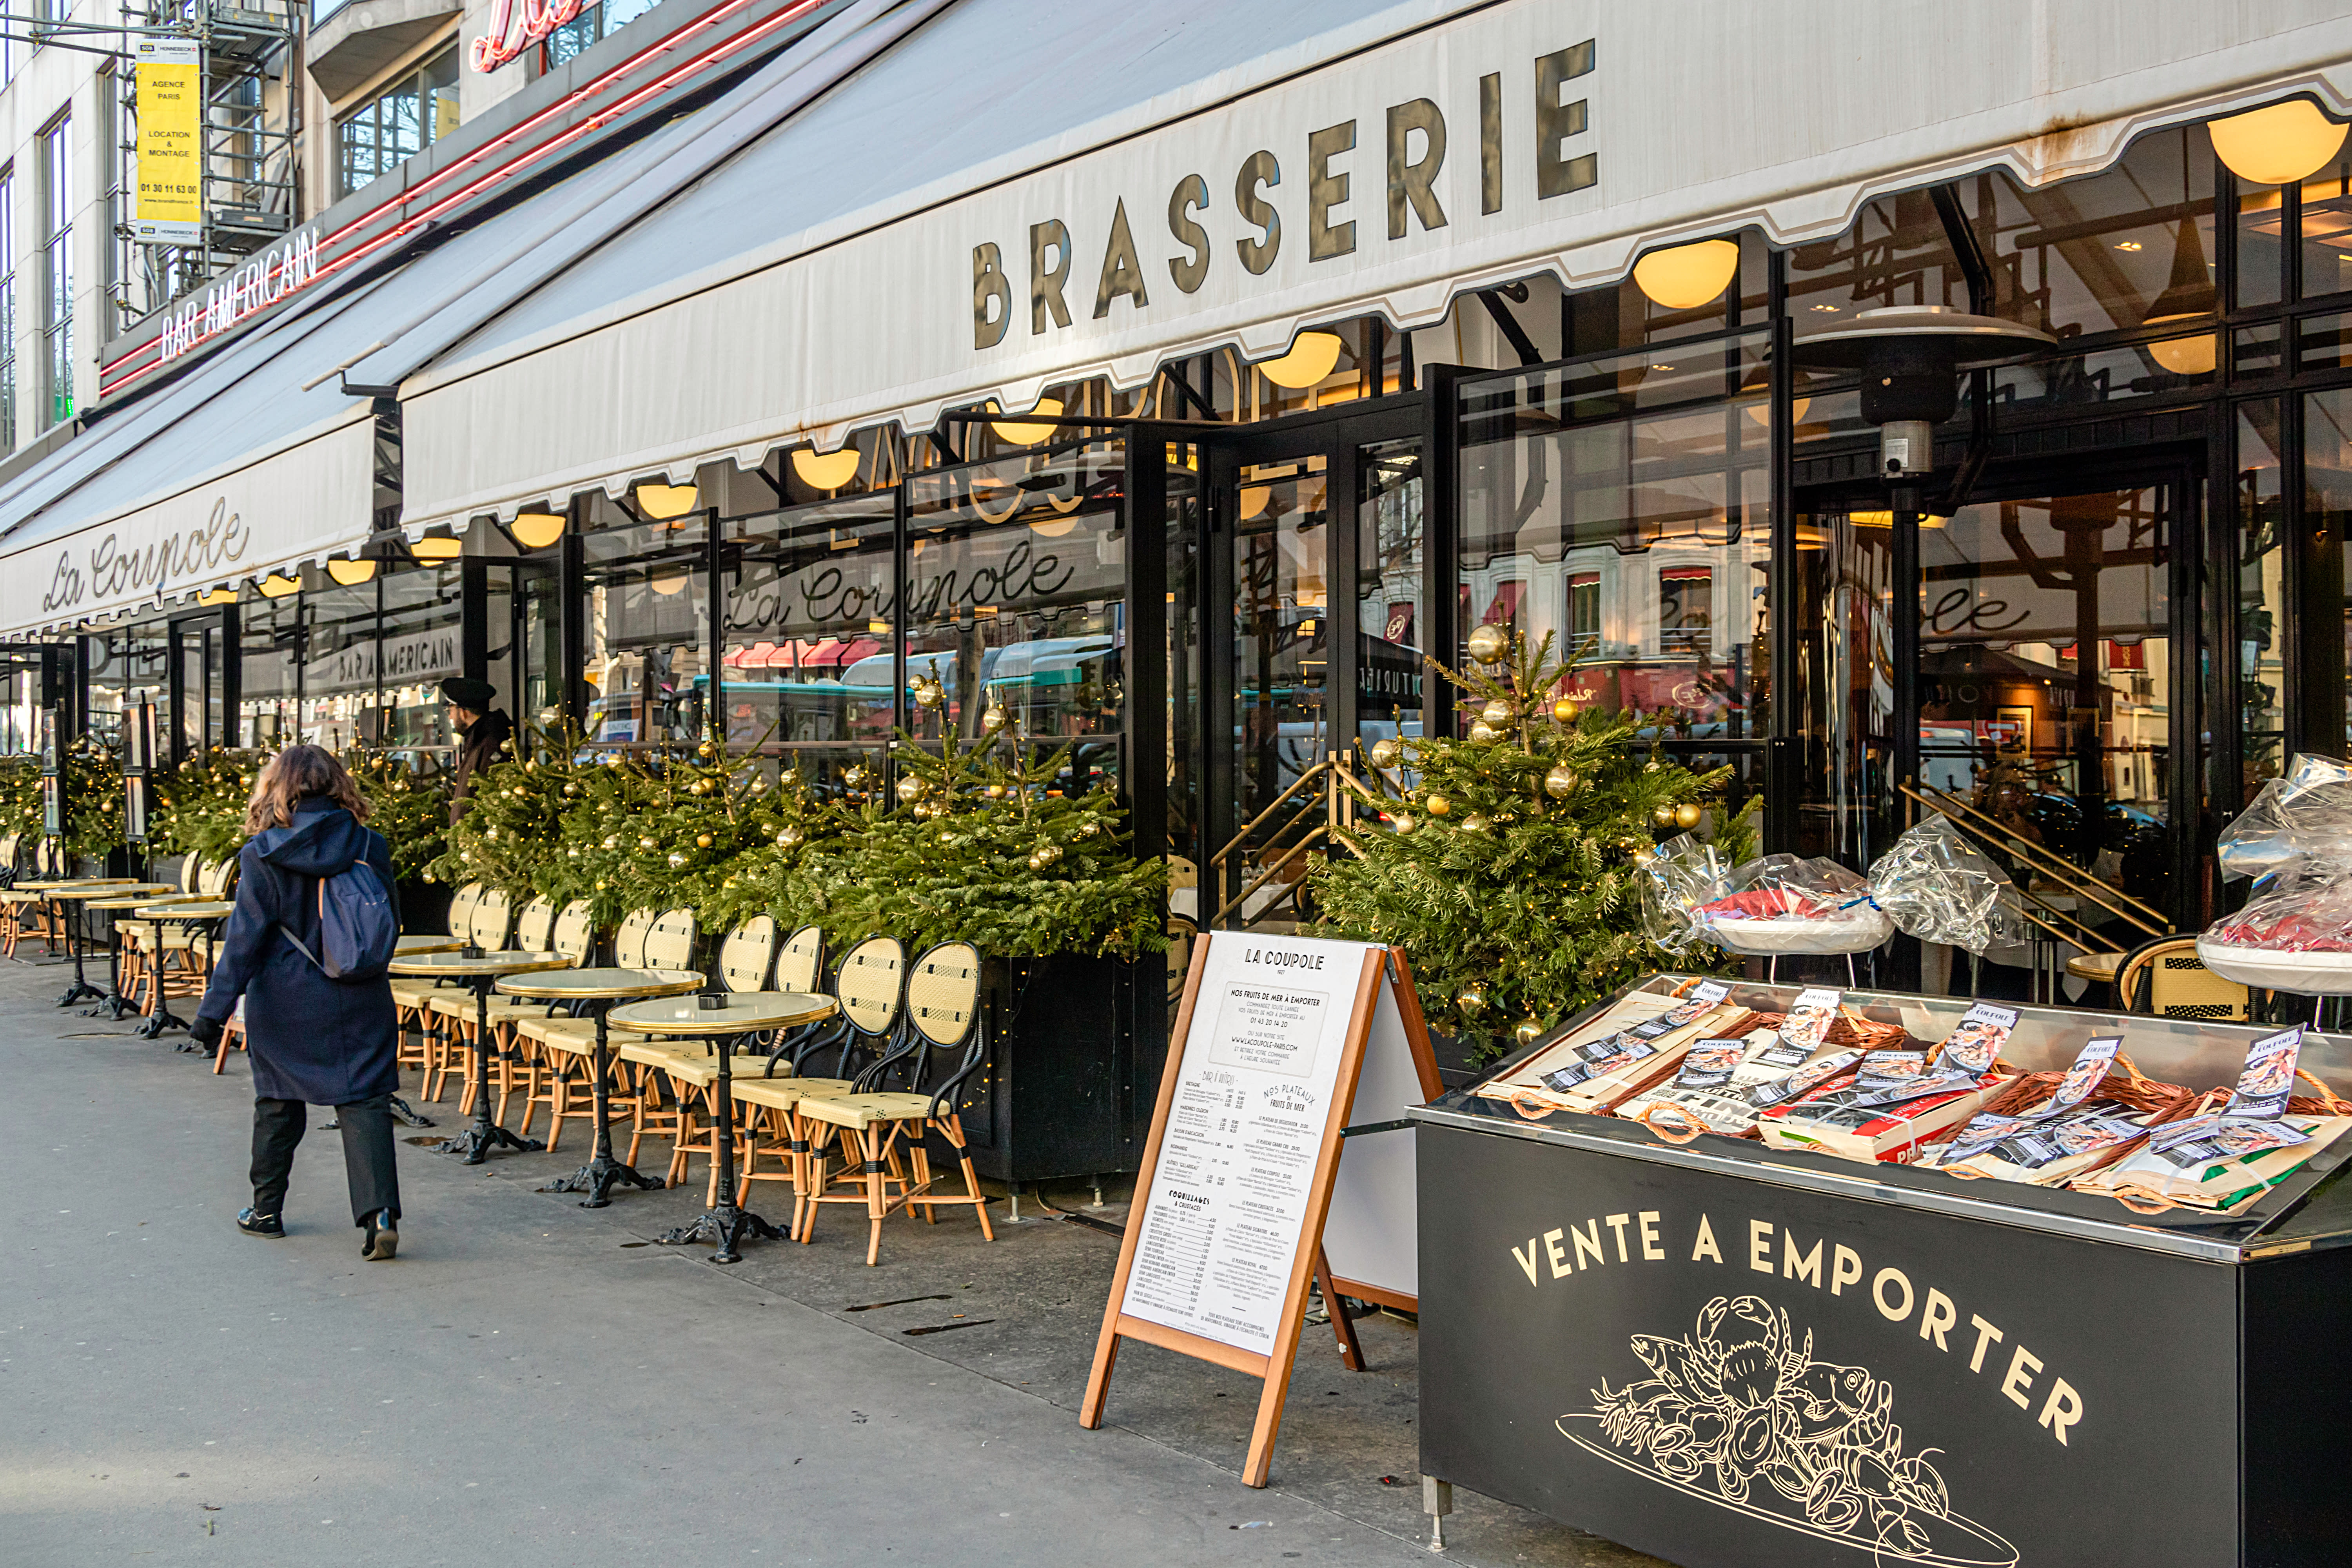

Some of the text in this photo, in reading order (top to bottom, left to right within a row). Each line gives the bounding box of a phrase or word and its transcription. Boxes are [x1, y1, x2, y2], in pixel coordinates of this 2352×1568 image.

[149, 149, 190, 158] MONTAGE
[141, 183, 150, 192] 01
[176, 185, 185, 193] 63
[188, 185, 197, 194] 00
[973, 38, 1599, 351] BRASSERIE
[162, 226, 317, 363] BAR AMERICAIN
[44, 496, 250, 612] La Coupole
[339, 653, 362, 682] BAR
[1245, 949, 1324, 970] LA COUPOLE
[1243, 990, 1261, 999] FRUITS
[1284, 994, 1289, 1003] À
[1290, 996, 1320, 1006] EMPORTER
[1701, 986, 1723, 998] COUPOLE
[1246, 1001, 1270, 1009] COMMANDEZ
[1976, 1009, 2009, 1021] COUPOLE
[1232, 1037, 1298, 1051] WWW.LACOUPOLE-PARIS.COM
[2258, 1036, 2293, 1053] COUPOLE
[1279, 1084, 1316, 1106] PLATEAUX
[1270, 1099, 1305, 1112] FRUITS DE MER
[1169, 1190, 1210, 1205] COQUILLAGES
[1178, 1201, 1201, 1212] CRUSTACÉS
[1511, 1210, 2084, 1447] VENTE A EMPORTER
